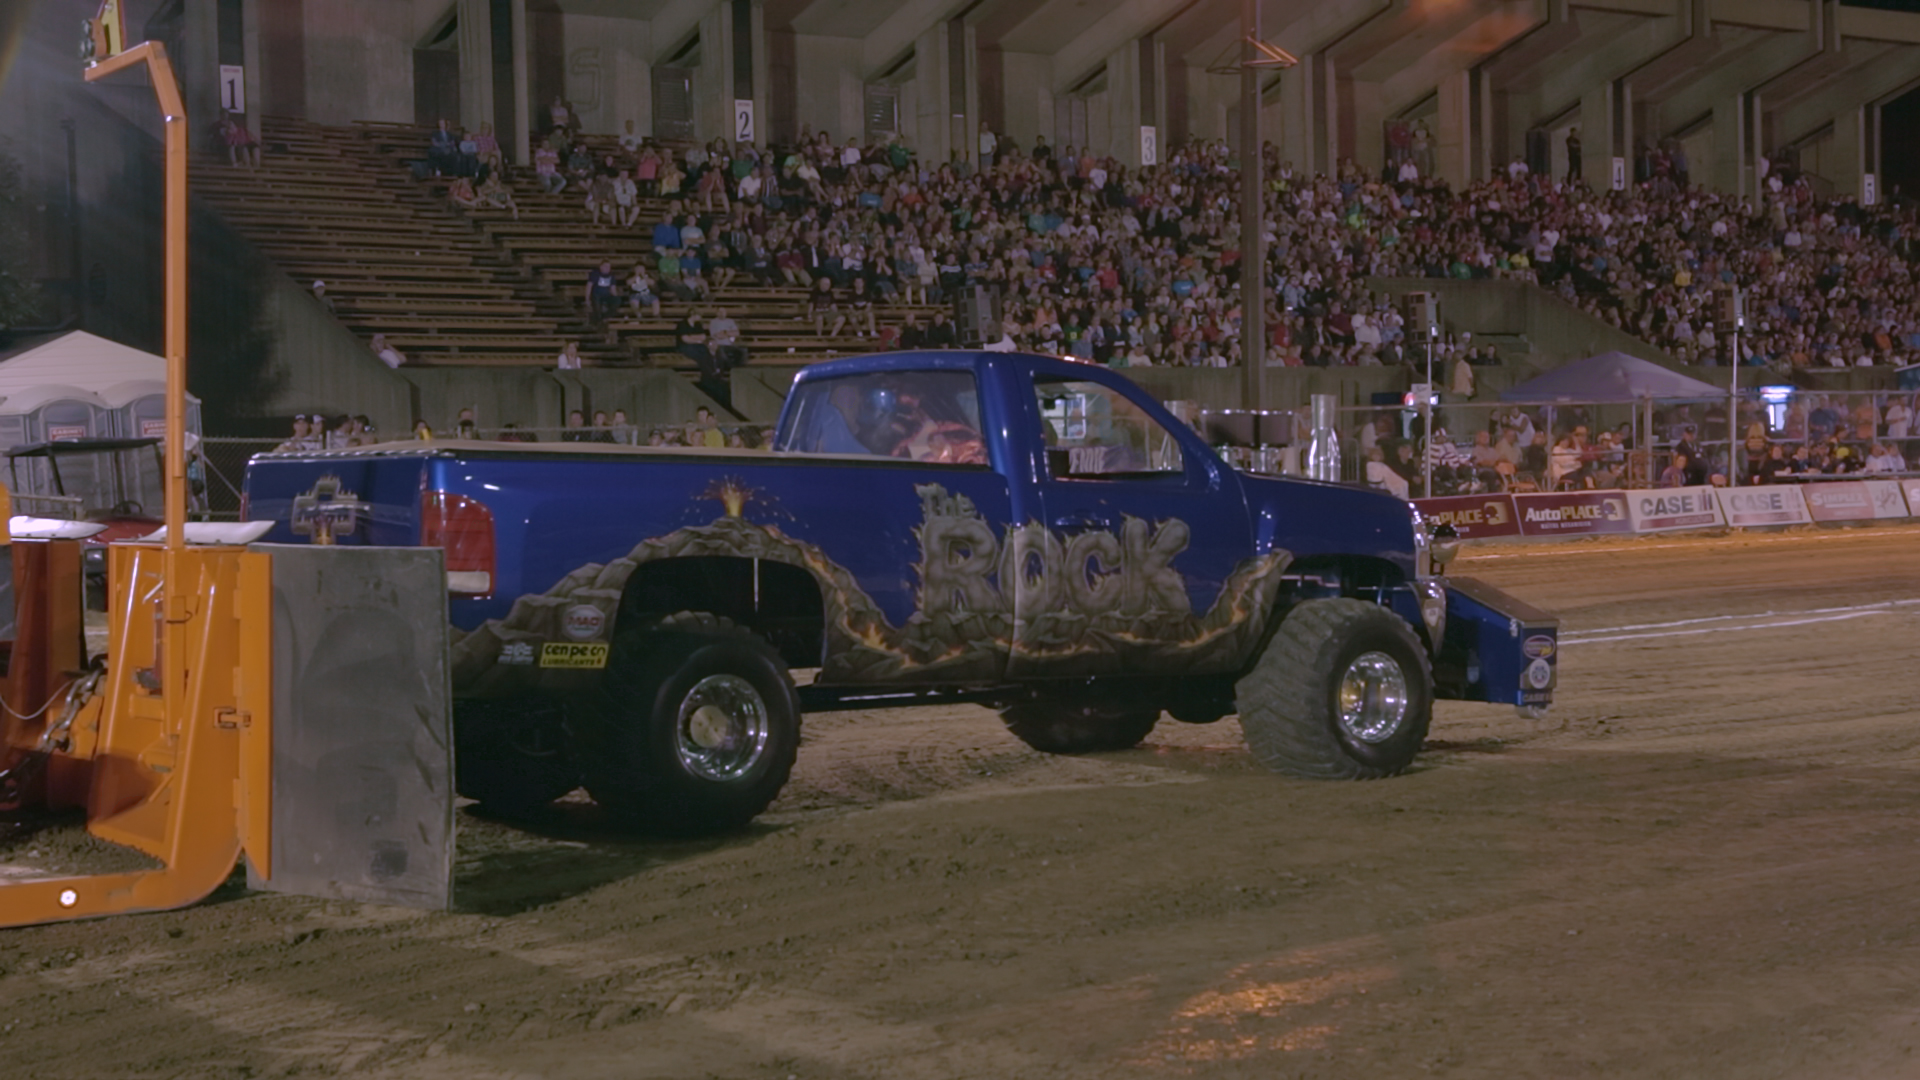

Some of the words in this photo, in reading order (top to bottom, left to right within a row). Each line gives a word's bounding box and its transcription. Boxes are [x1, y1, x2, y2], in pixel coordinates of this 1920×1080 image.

[227, 78, 238, 110] 1
[739, 111, 750, 139] 2
[1144, 136, 1153, 163] 3
[914, 483, 977, 517] The
[1525, 505, 1602, 522] AutoPLACE
[1640, 495, 1694, 517] CASE
[1730, 493, 1783, 511] CASE
[919, 513, 1191, 616] ROCK
